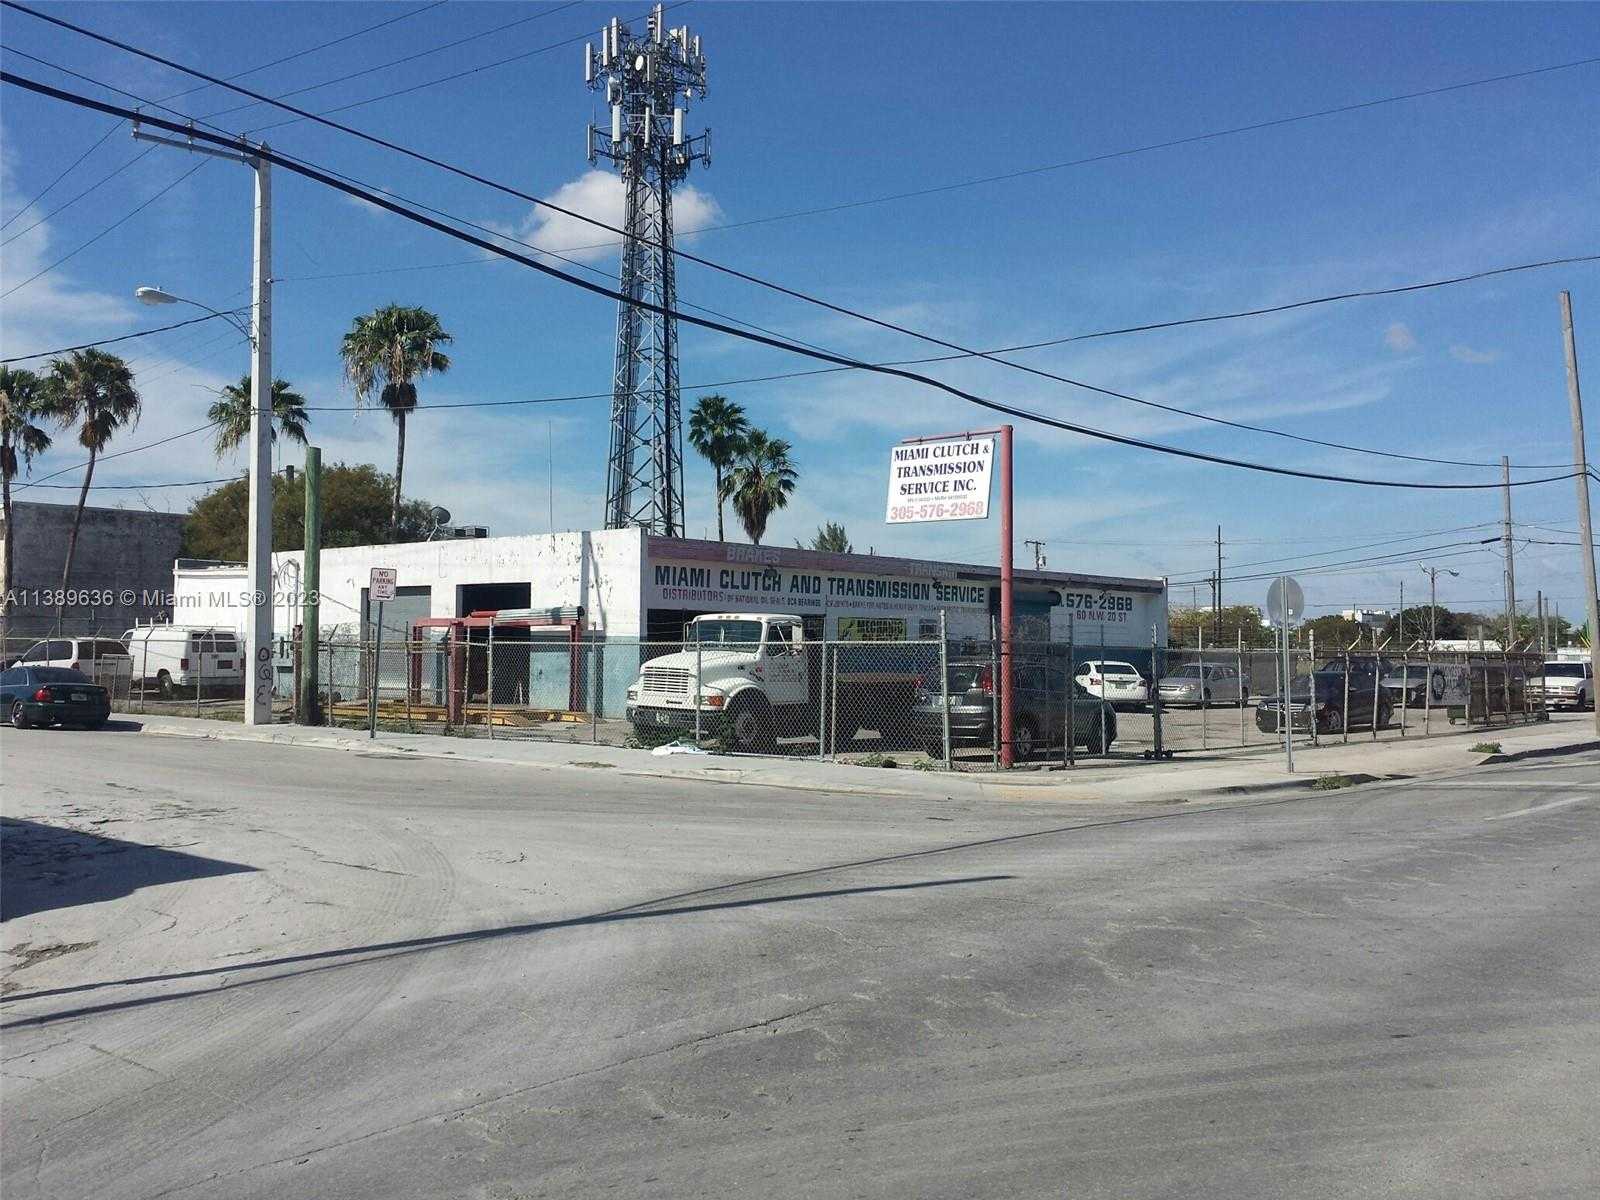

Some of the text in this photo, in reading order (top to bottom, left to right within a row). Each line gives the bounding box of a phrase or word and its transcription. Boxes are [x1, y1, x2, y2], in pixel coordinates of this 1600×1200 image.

[895, 443, 990, 461] MIAMI CLUTCH &
[897, 460, 984, 478] TRANSMISSION
[899, 479, 976, 495] SERVICE INC.
[890, 501, 984, 519] 305-576-2968
[655, 565, 985, 603] MIAMI CLUTCH AND TRANSMISSION SERVICE
[662, 587, 725, 602] DISTRIBUTORS
[1066, 593, 1132, 611] 576-2968
[1076, 609, 1086, 620] 60
[1107, 612, 1117, 622] 20
